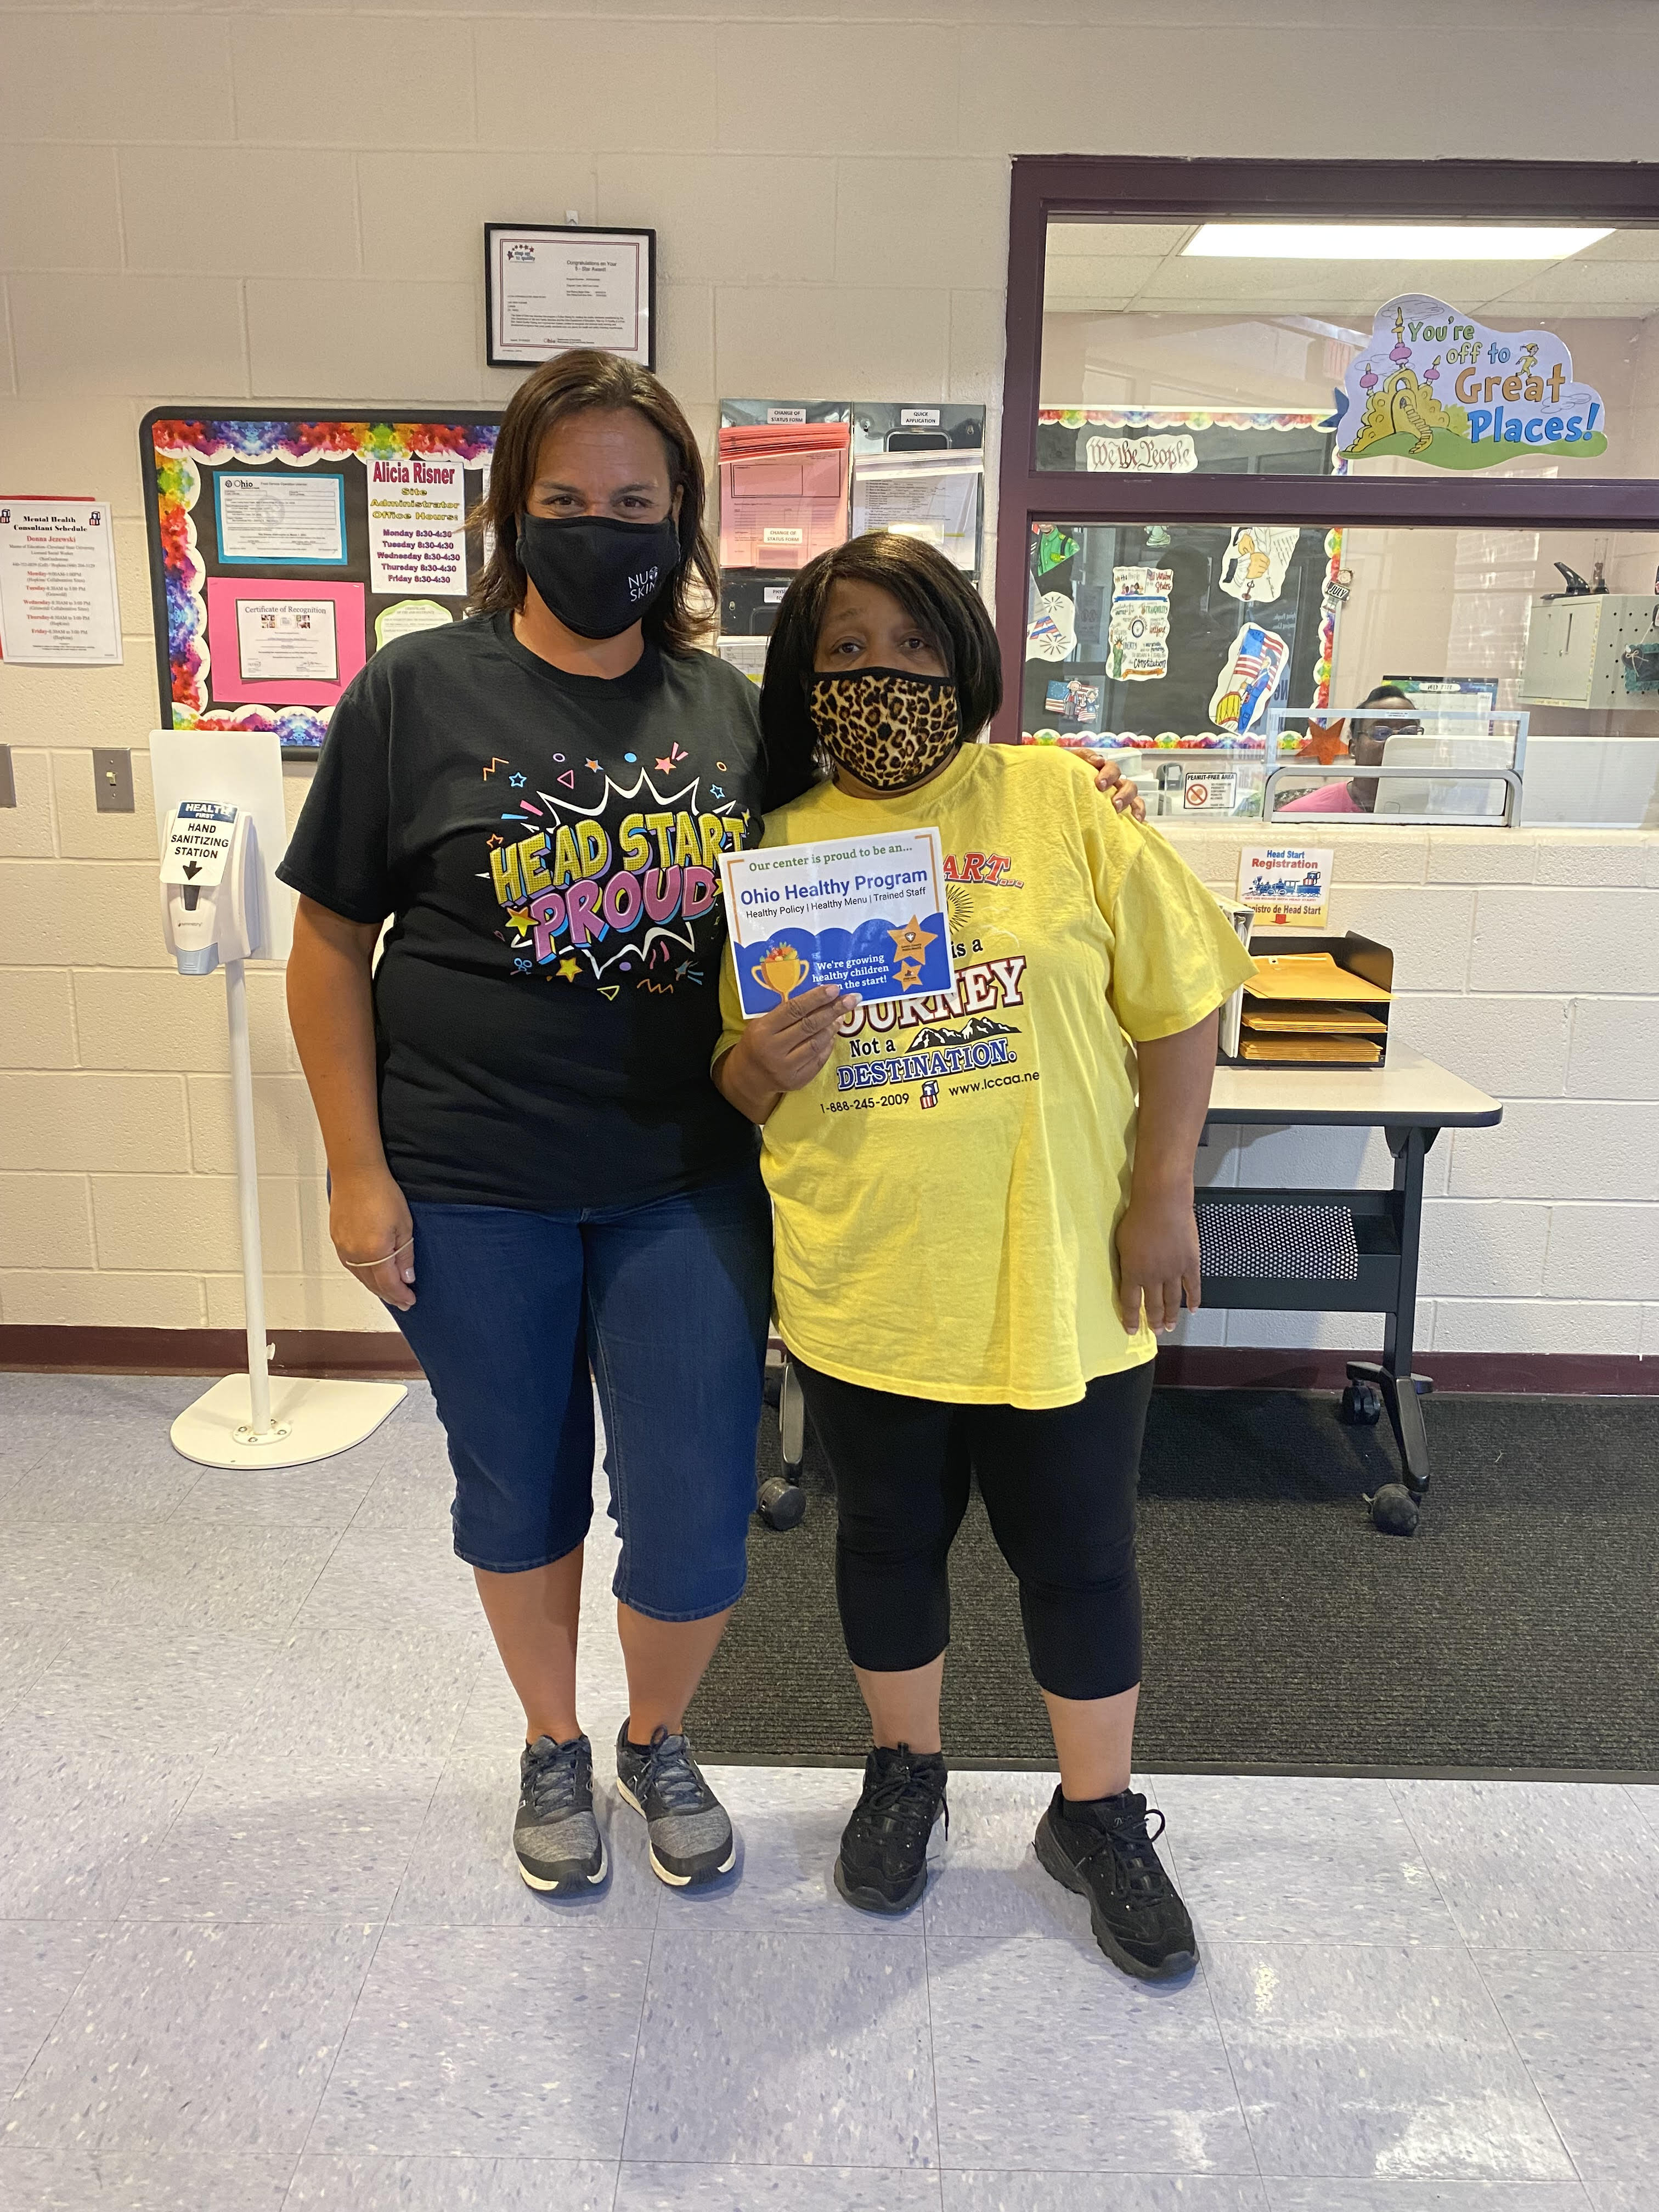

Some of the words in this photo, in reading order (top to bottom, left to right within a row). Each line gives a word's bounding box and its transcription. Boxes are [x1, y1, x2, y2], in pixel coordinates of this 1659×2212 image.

[1408, 316, 1475, 342] You're
[1446, 341, 1483, 364] off
[1488, 342, 1511, 364] to
[1455, 363, 1566, 404] Great
[1468, 402, 1600, 444] Places!
[1087, 438, 1118, 470] We
[1137, 439, 1190, 470] People
[373, 461, 410, 483] Alicia
[413, 462, 455, 484] Risner
[401, 487, 427, 496] Site
[370, 499, 460, 509] Administrator
[373, 511, 411, 520] Office
[415, 512, 458, 521] Hours:
[383, 529, 414, 538] Monday
[382, 540, 415, 549] Tuesday
[377, 551, 422, 561] Wednesday
[381, 563, 418, 572] Thursday
[388, 574, 412, 584] Friday
[628, 571, 648, 589] NU
[630, 582, 655, 601] SKIN
[1329, 585, 1347, 597] JULY
[185, 803, 232, 816] HEALTH
[188, 823, 216, 833] HAND
[171, 834, 229, 848] SANITIZING
[174, 847, 218, 859] STATION
[490, 819, 610, 906] HEAD
[618, 811, 746, 874] START
[749, 862, 770, 872] Our
[772, 856, 809, 868] center
[811, 854, 821, 864] is
[823, 849, 856, 866] proud
[859, 848, 871, 857] to
[873, 844, 885, 855] be
[889, 844, 913, 854] an...
[1267, 850, 1285, 858] Head
[1287, 850, 1305, 859] Start
[944, 852, 1024, 889] ART...
[1251, 858, 1318, 870] Registration
[741, 889, 780, 905] Ohio
[785, 878, 850, 900] Healthy
[855, 869, 928, 891] Program
[746, 906, 777, 919] Healthy
[780, 904, 804, 916] Policy
[811, 899, 842, 911] Healthy
[844, 896, 867, 905] Menu
[873, 890, 904, 902] Trained
[906, 887, 926, 897] Staff
[1244, 904, 1271, 913] gistro
[1273, 905, 1282, 913] de
[1284, 906, 1301, 914] Head
[1304, 906, 1321, 915] Start
[531, 865, 716, 964] PROUD
[951, 941, 966, 959] is
[972, 939, 984, 953] a
[816, 961, 844, 970] We're
[846, 955, 884, 969] growing
[812, 970, 849, 983] healthy
[850, 965, 889, 977] children
[845, 980, 860, 989] the
[862, 974, 887, 986] start!
[849, 1039, 881, 1058] Not
[885, 1038, 896, 1052] a
[837, 1037, 1017, 1092] DESTINATION.
[820, 1093, 910, 1114] 1-888-245-2009
[949, 1070, 1040, 1097] www.lccaa.ne
